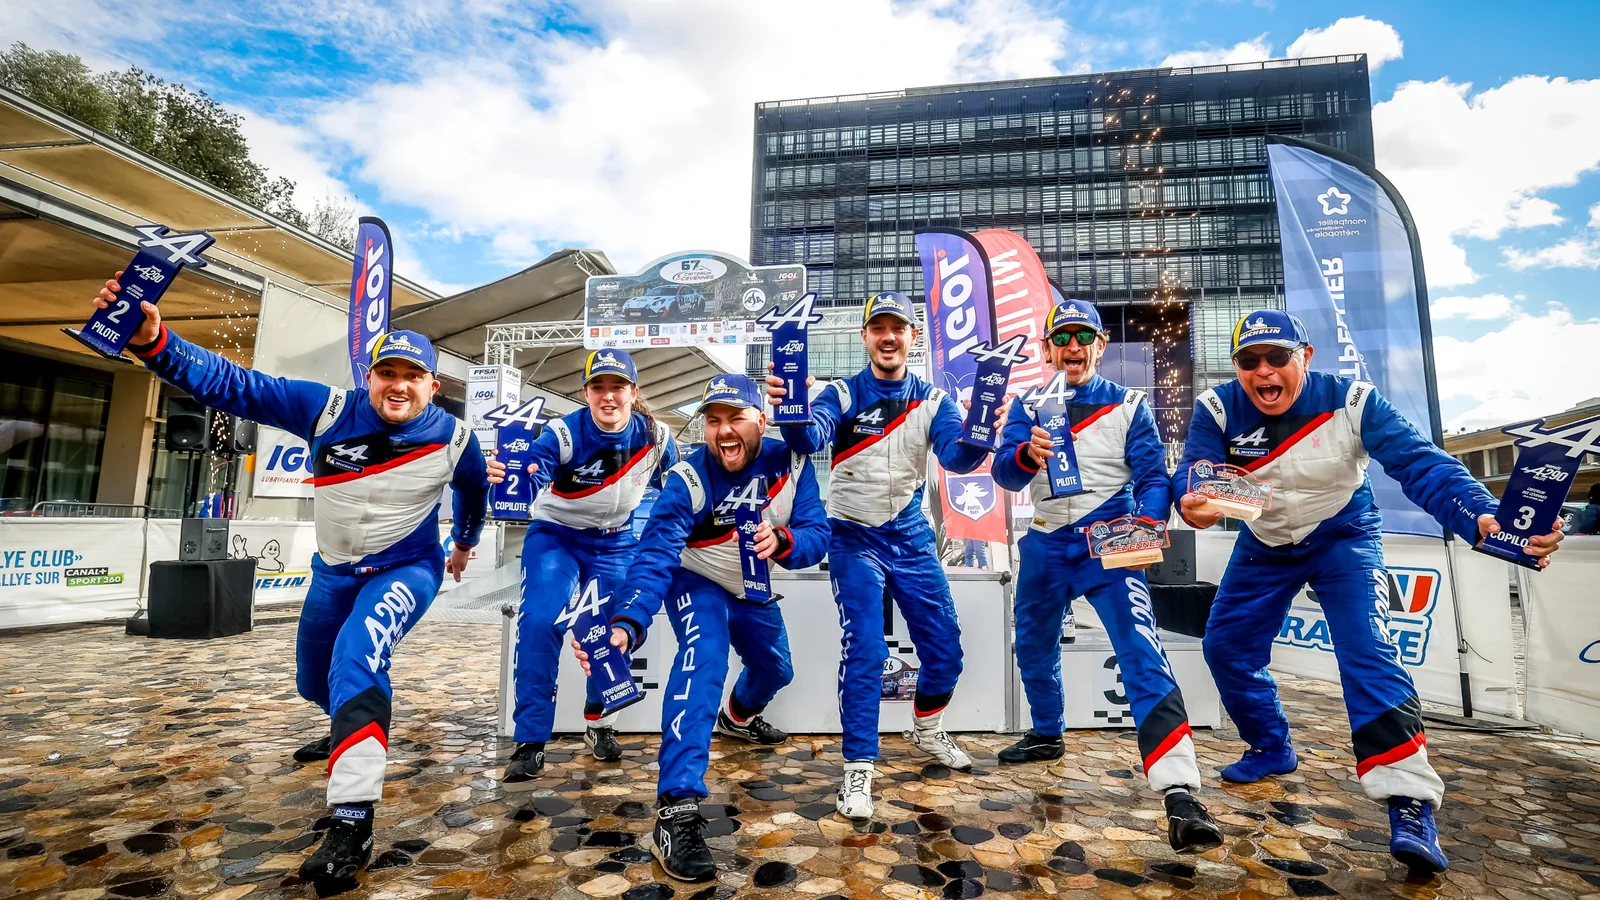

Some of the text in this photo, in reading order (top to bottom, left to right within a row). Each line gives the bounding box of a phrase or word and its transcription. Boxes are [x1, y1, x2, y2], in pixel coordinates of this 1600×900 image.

[682, 260, 700, 271] 67
[133, 264, 165, 284] A290
[107, 300, 130, 324] 2
[871, 303, 904, 312] MICHELIN
[1053, 312, 1089, 324] MICHELIN
[91, 320, 121, 344] PILOTE
[1239, 328, 1281, 341] MICHELIN
[380, 344, 423, 356] MICHELIN
[776, 340, 804, 354] A290
[591, 361, 626, 370] MICHELIN
[979, 373, 1005, 386] A290
[475, 390, 495, 398] IGOL
[787, 379, 794, 400] 1
[1350, 386, 1365, 408] Sabelt
[327, 394, 343, 418] Sabelt
[779, 404, 804, 415] PILOTE
[1208, 396, 1223, 415] Sabelt
[981, 404, 988, 424] 1
[971, 424, 990, 435] ALPINE
[1044, 416, 1065, 429] A290
[455, 426, 467, 448] Sabelt
[558, 427, 571, 448] Sabelt
[970, 431, 988, 442] STORE
[503, 439, 530, 452] A290
[1057, 452, 1069, 472] 3
[261, 476, 300, 484] LUBRIFIANTS
[682, 468, 699, 488] Sabelt
[1056, 476, 1077, 488] PILOTE
[1520, 466, 1569, 482] A290
[506, 474, 520, 495] 2
[495, 501, 528, 512] COPILOTE
[1513, 505, 1536, 530] 3
[1490, 532, 1530, 549] COPILO
[66, 568, 107, 577] CANAL+
[748, 556, 756, 576] 1
[0, 572, 60, 587] LLYE SUR
[70, 577, 101, 585] SPORT
[744, 579, 767, 592] COPILOTE
[364, 581, 416, 673] A290
[581, 625, 607, 644] A290
[603, 661, 616, 682] 1
[671, 592, 700, 742] ALPINE
[884, 661, 894, 671] 26
[1103, 655, 1130, 705] 3
[602, 680, 632, 698] PERFORMER
[610, 686, 635, 702] RAGNOTTI
